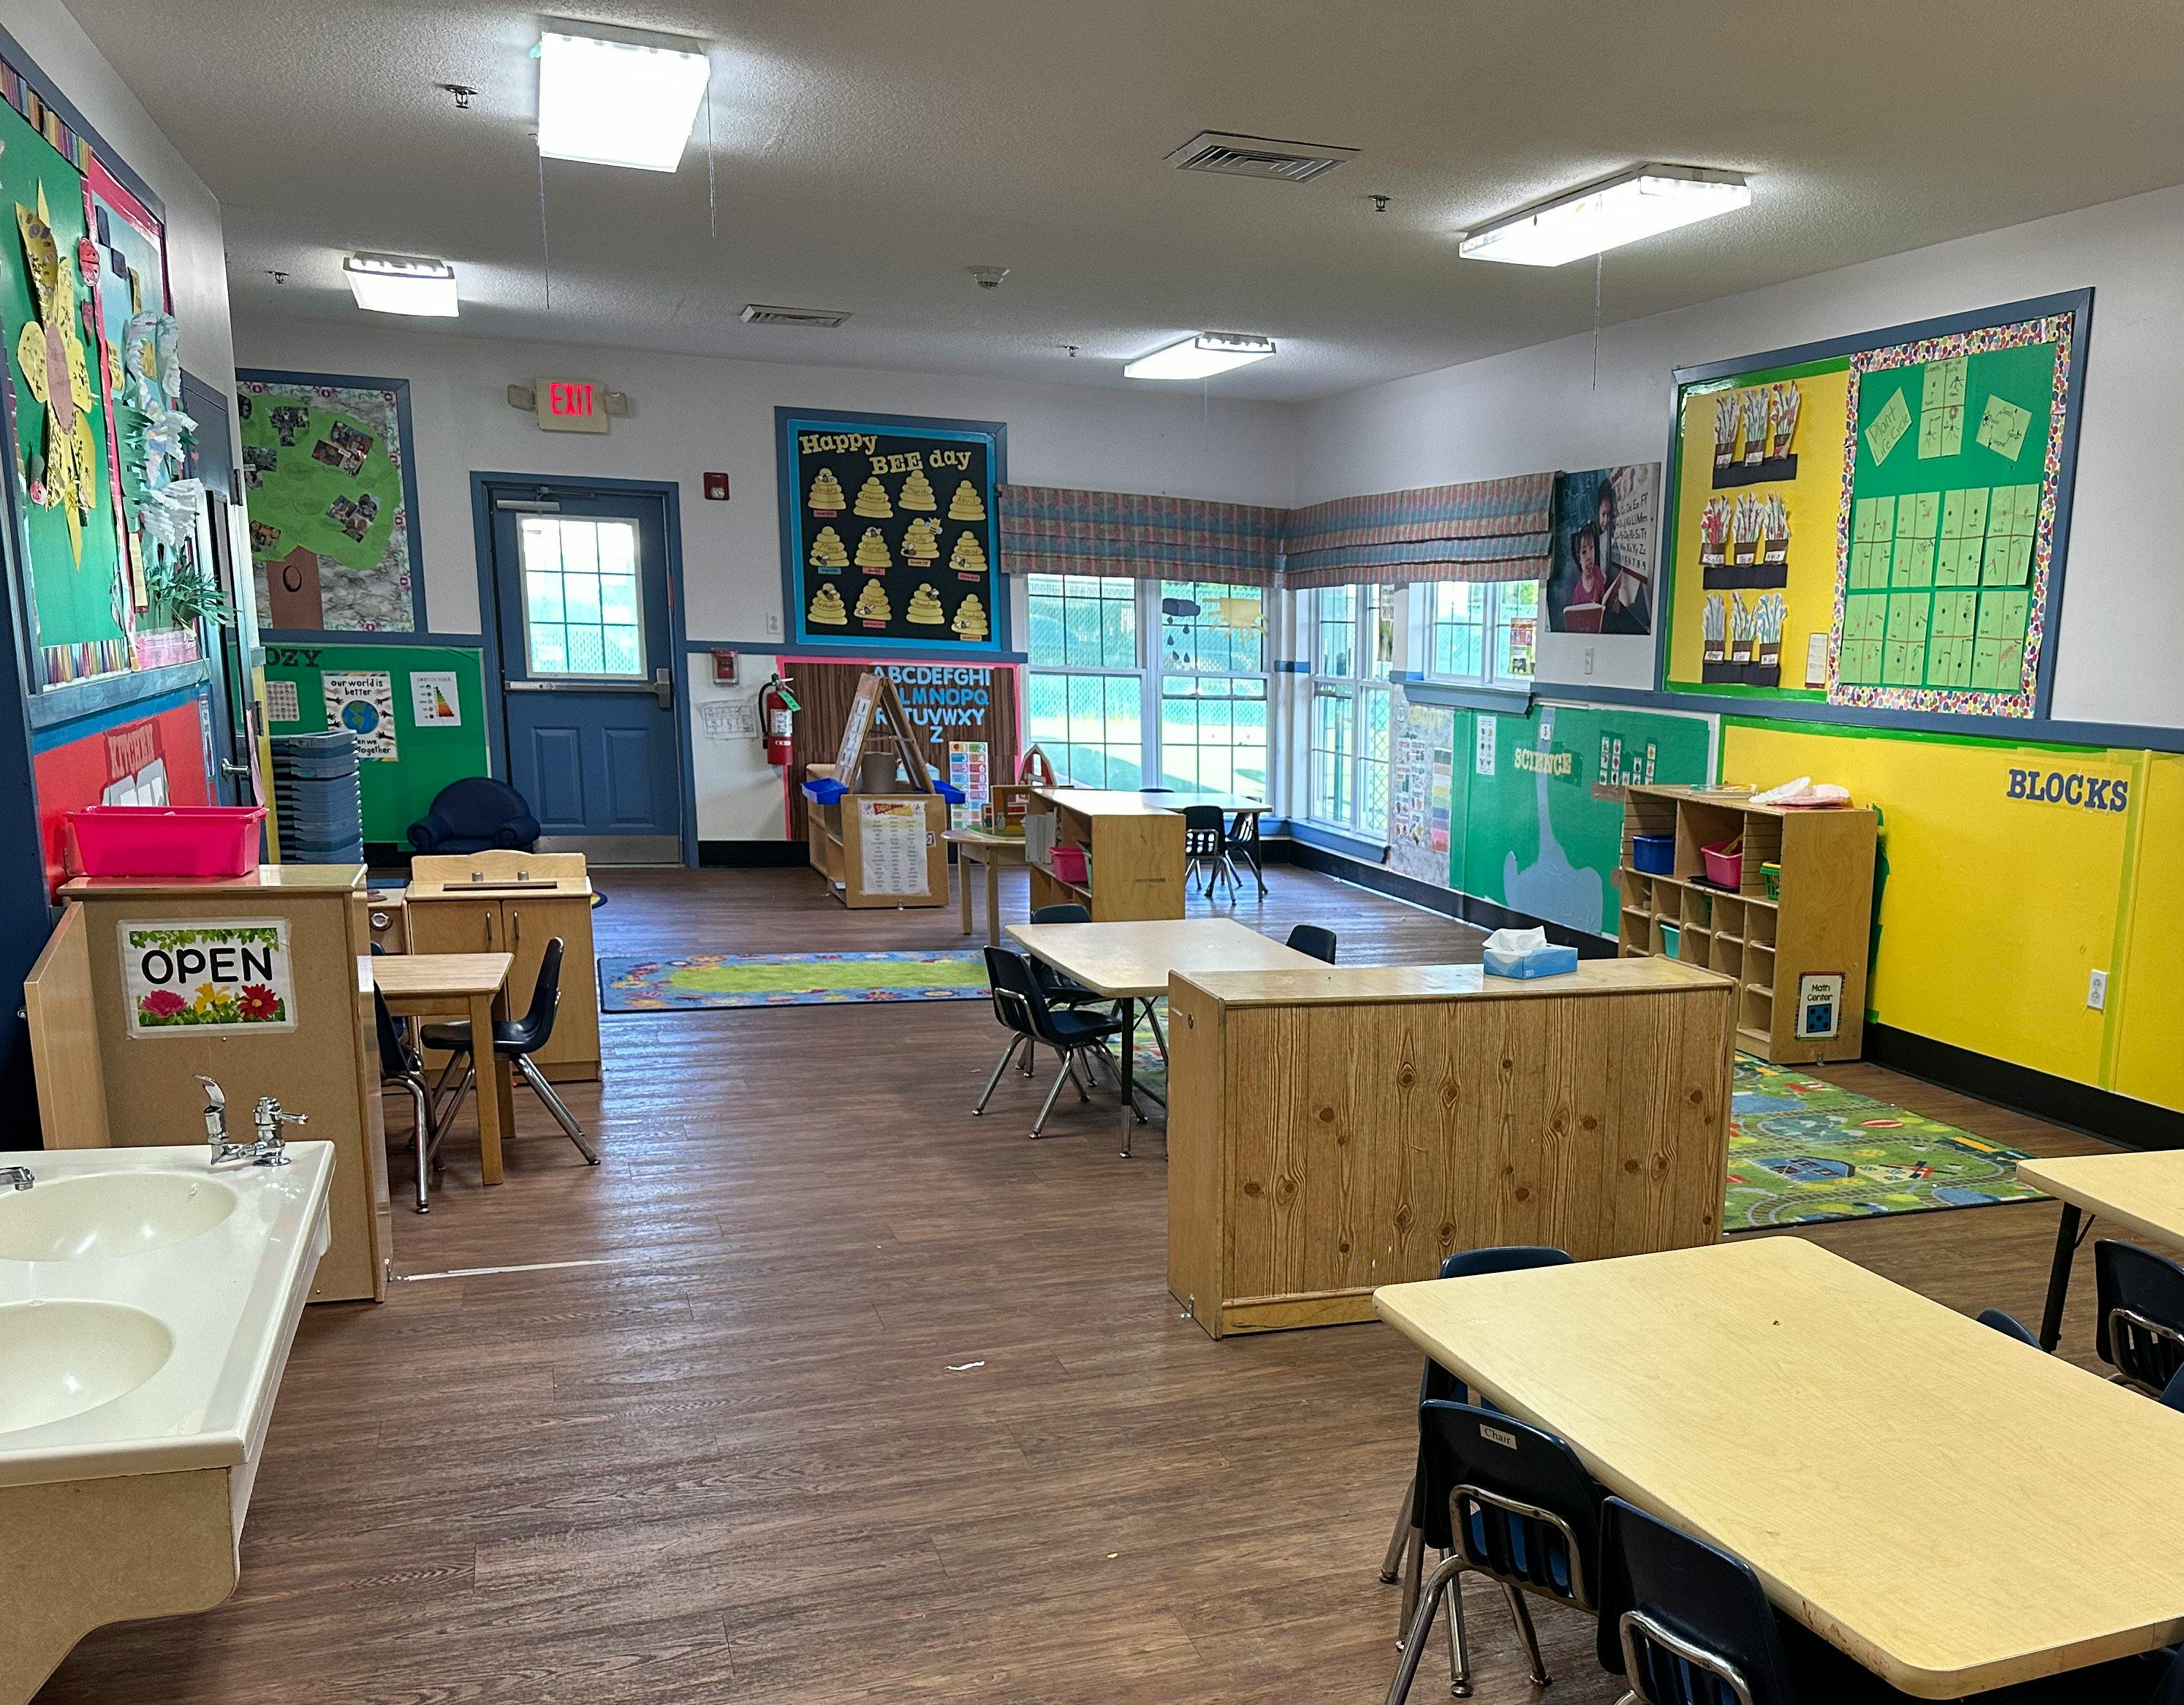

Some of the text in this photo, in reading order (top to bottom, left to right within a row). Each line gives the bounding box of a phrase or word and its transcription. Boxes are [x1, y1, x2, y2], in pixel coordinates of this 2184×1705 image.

[550, 382, 594, 416] EXIT
[1868, 403, 1895, 444] Plant
[1892, 414, 1910, 439] Cycle
[799, 433, 878, 455] Happy
[870, 450, 971, 475] BEE day
[344, 687, 372, 695] better
[348, 678, 374, 687] world
[376, 679, 383, 687] is
[930, 725, 944, 743] Z
[107, 722, 155, 779] KITCHEN
[962, 754, 968, 762] 3
[979, 744, 986, 752] 2
[979, 764, 985, 772] 6
[1514, 747, 1572, 775] SCIENCE
[2006, 768, 2128, 812] BLOCKS
[141, 947, 273, 985] OPEN
[1807, 994, 1833, 1002] Center
[1812, 984, 1831, 992] Math
[1485, 1427, 1512, 1444] Chair
